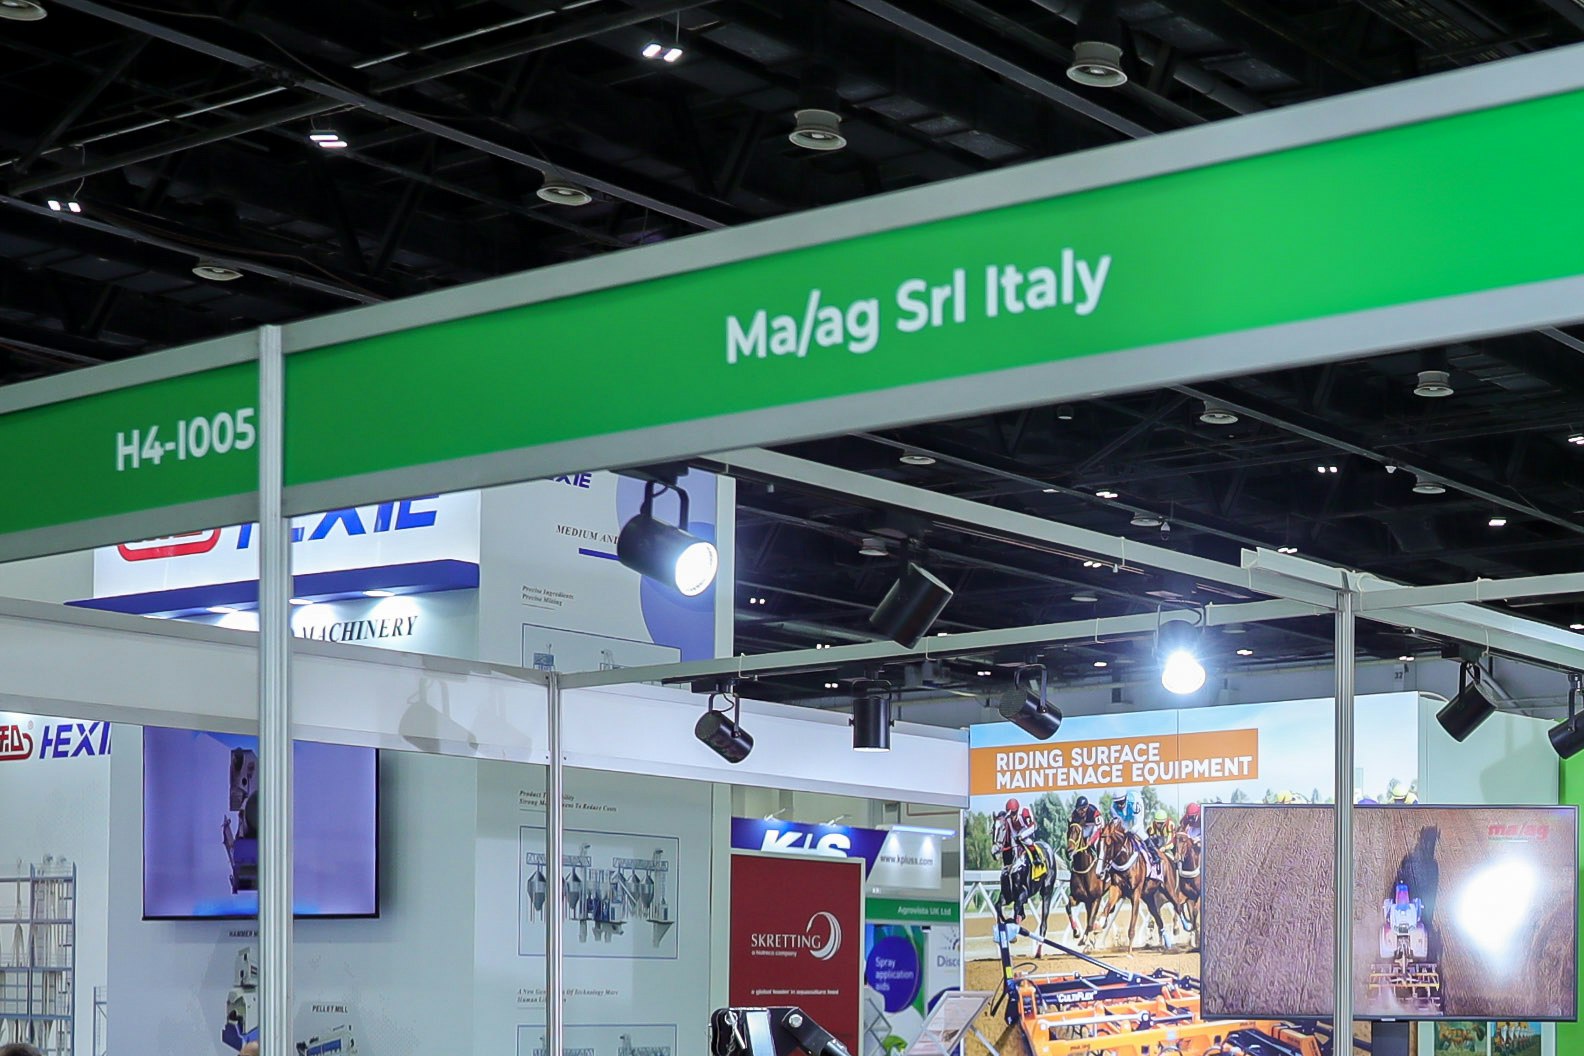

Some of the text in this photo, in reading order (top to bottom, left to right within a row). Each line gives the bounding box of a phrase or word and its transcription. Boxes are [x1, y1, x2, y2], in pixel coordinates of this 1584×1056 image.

[726, 248, 1111, 364] Ma/ag Srl Italy
[116, 408, 255, 471] H4-I005
[556, 525, 598, 541] MEDIUM
[303, 616, 418, 642] MACHINERY
[39, 721, 111, 759] HEXI
[996, 742, 1160, 771] RIDING SURFACE
[996, 756, 1253, 790] MAINTENACE EQUIPMENT
[751, 933, 821, 949] SKRETTING
[875, 957, 896, 969] Spray
[875, 970, 914, 980] application
